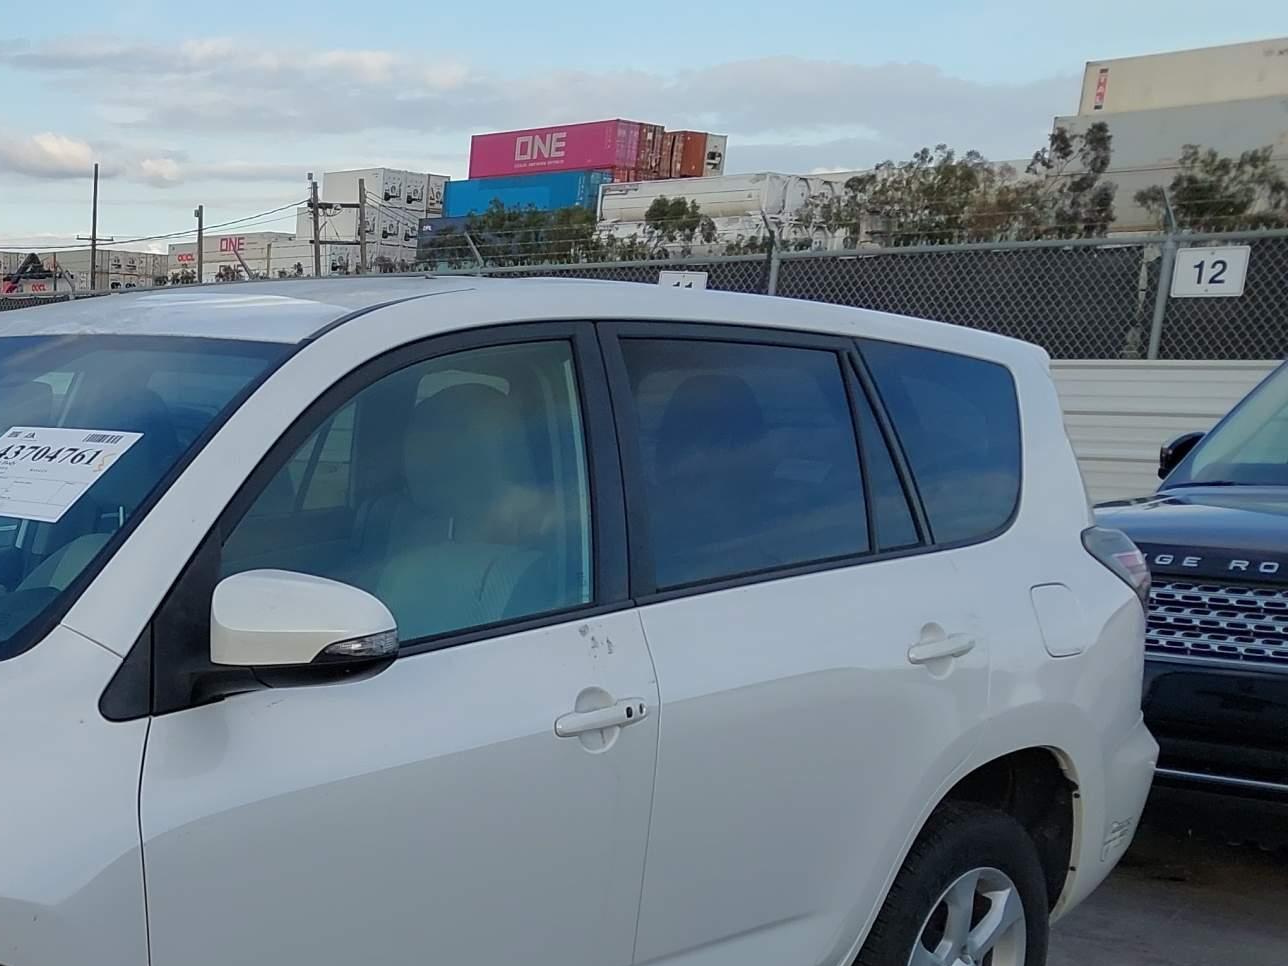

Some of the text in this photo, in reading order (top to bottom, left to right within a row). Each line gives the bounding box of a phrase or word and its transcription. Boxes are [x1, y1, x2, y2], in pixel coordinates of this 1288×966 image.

[515, 132, 567, 161] ONE
[219, 236, 245, 253] ONE
[1193, 259, 1228, 285] 12
[1228, 559, 1280, 574] RO
